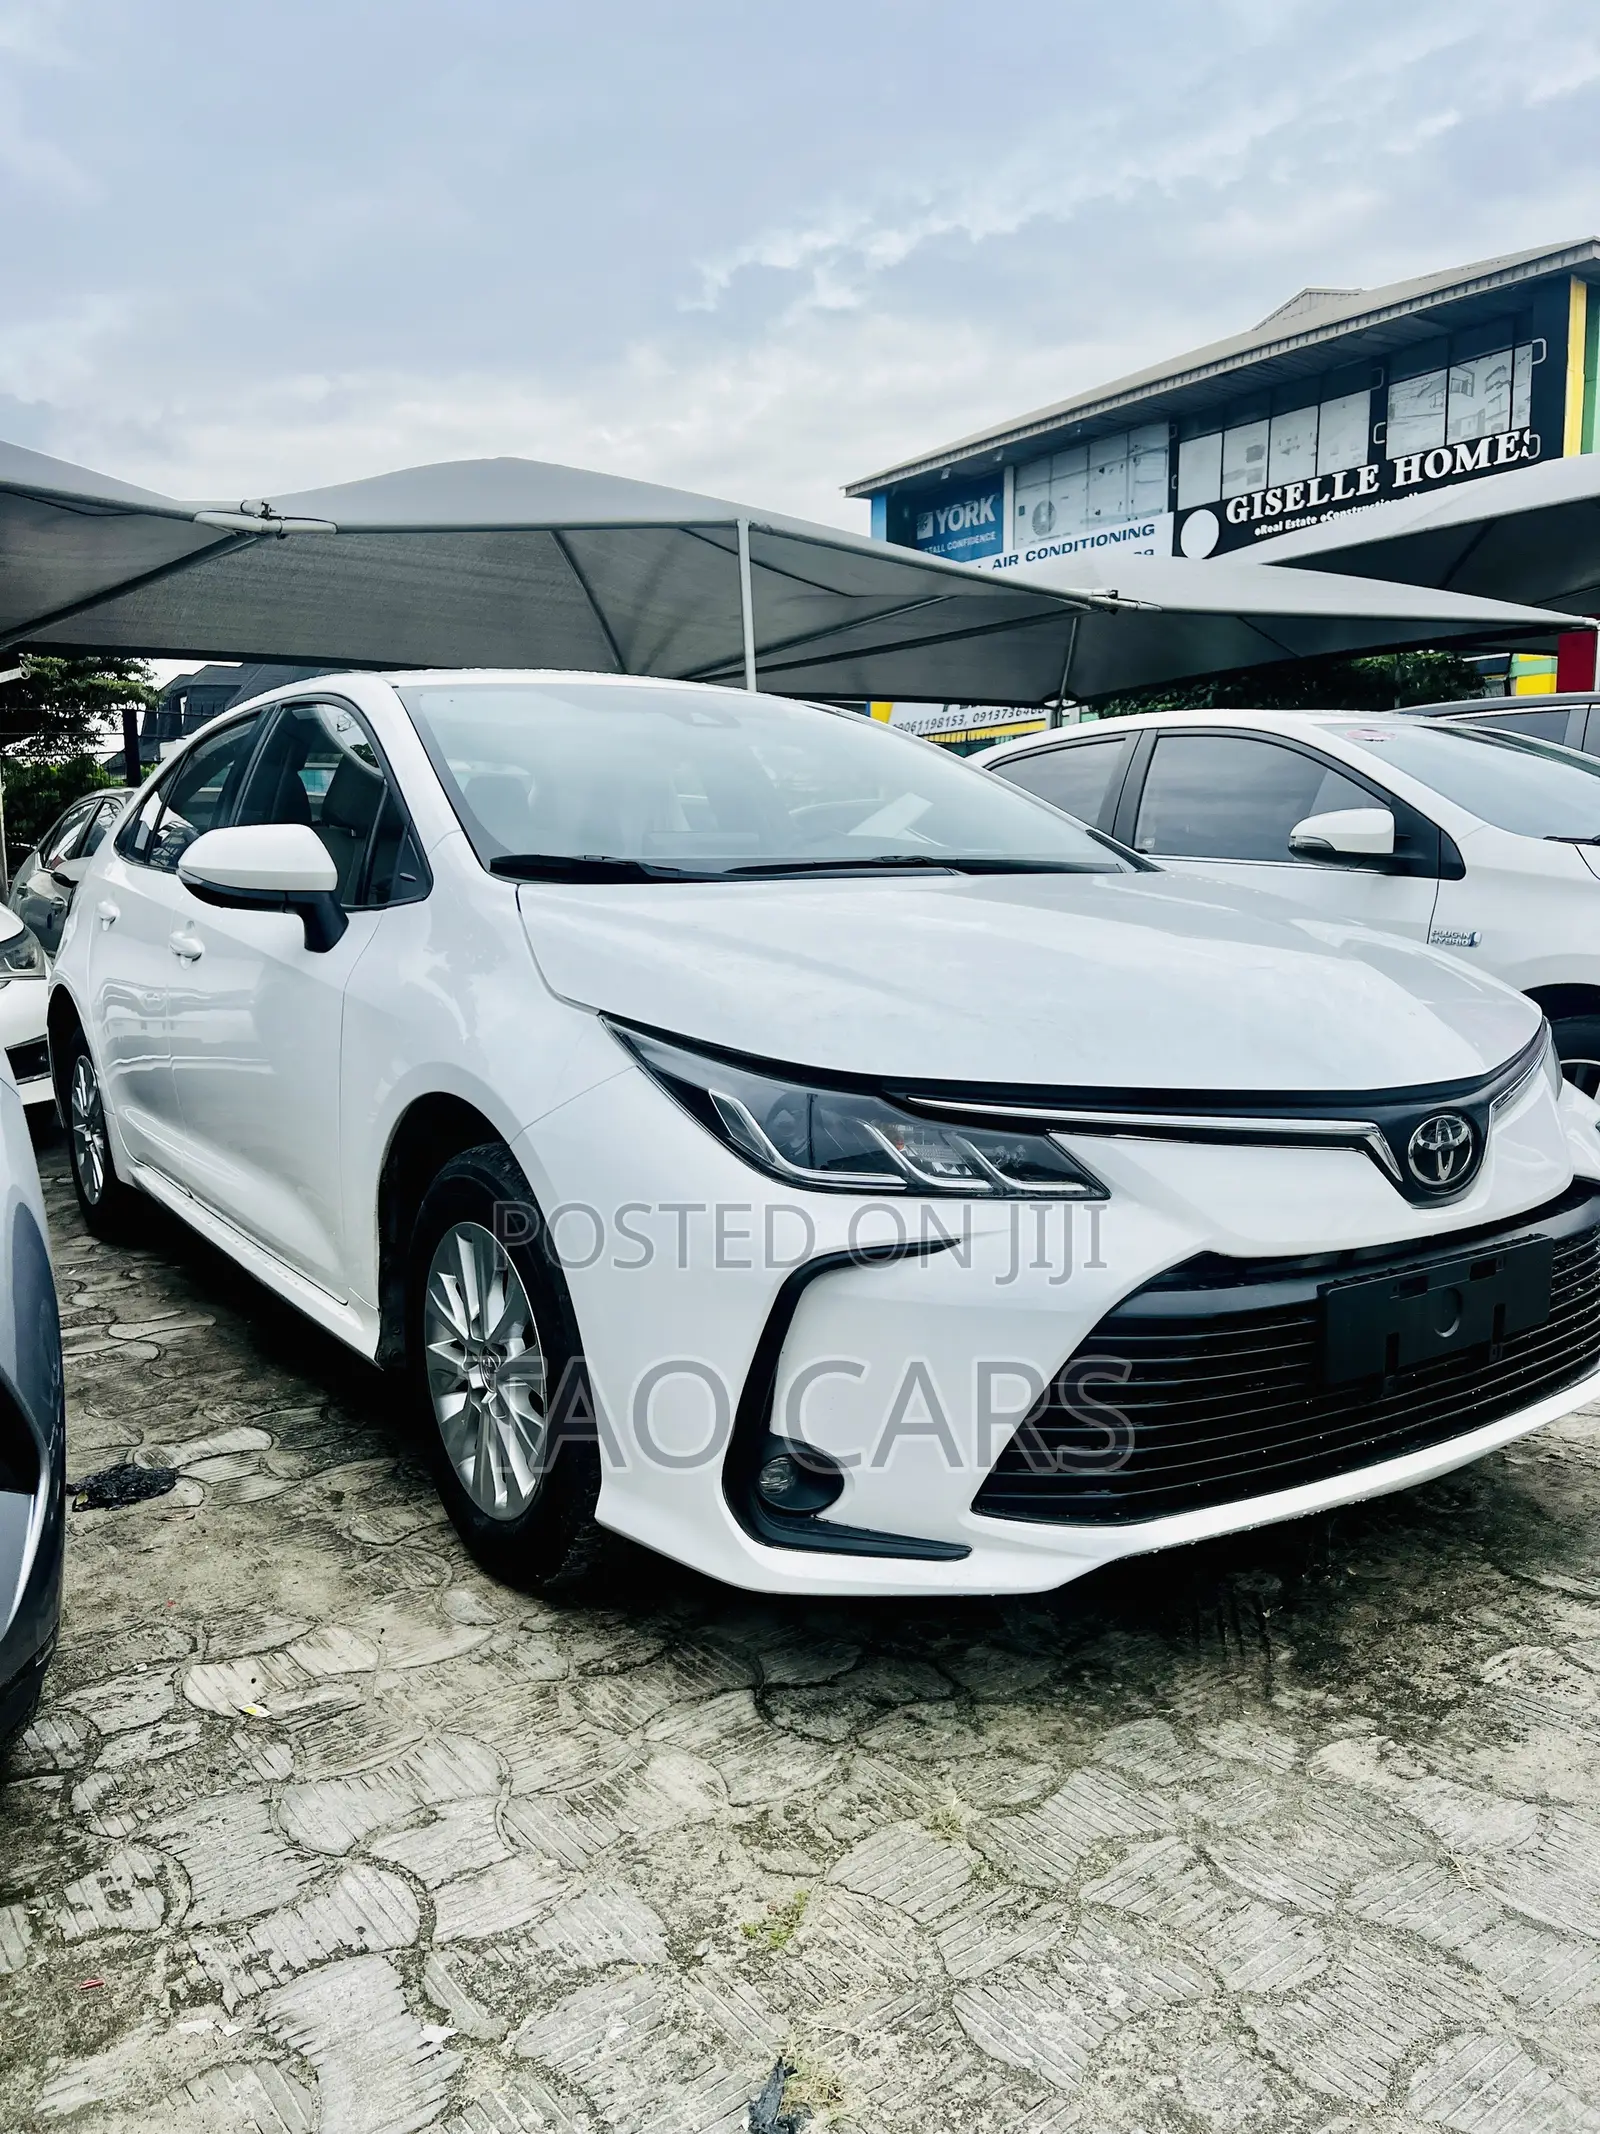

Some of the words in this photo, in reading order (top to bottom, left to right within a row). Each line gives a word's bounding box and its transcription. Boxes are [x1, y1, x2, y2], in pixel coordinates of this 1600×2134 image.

[936, 494, 996, 535] YORK
[1225, 464, 1381, 524] GISELLE
[947, 530, 997, 551] CONFIDENCE
[1285, 515, 1318, 530] Estate
[992, 554, 1019, 570] AIR
[1025, 524, 1156, 563] CONDITIONING
